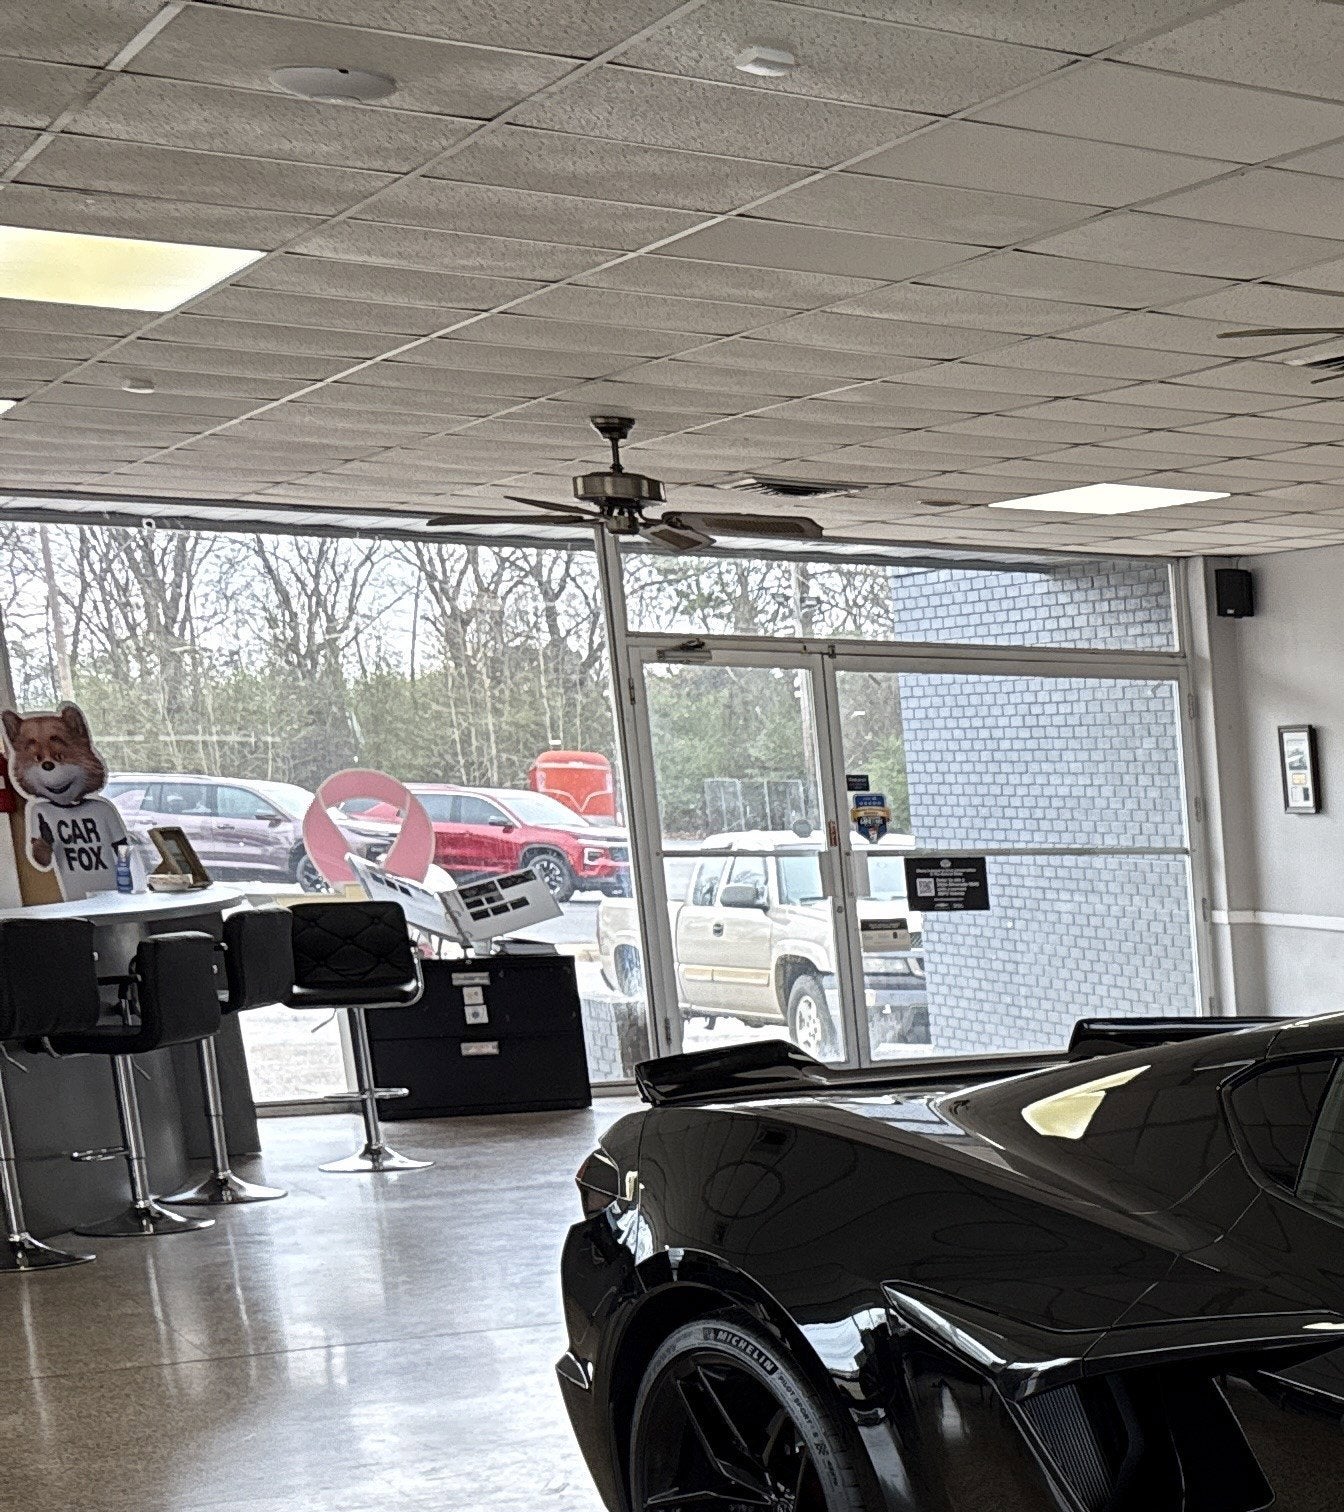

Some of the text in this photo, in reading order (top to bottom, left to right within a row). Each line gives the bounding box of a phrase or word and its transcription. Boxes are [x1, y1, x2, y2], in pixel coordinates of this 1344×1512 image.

[57, 818, 100, 844] CAR
[64, 846, 108, 871] FOX
[717, 1330, 774, 1372] MICHELIN
[778, 1376, 795, 1396] PILOT
[794, 1397, 813, 1424] SPORT
